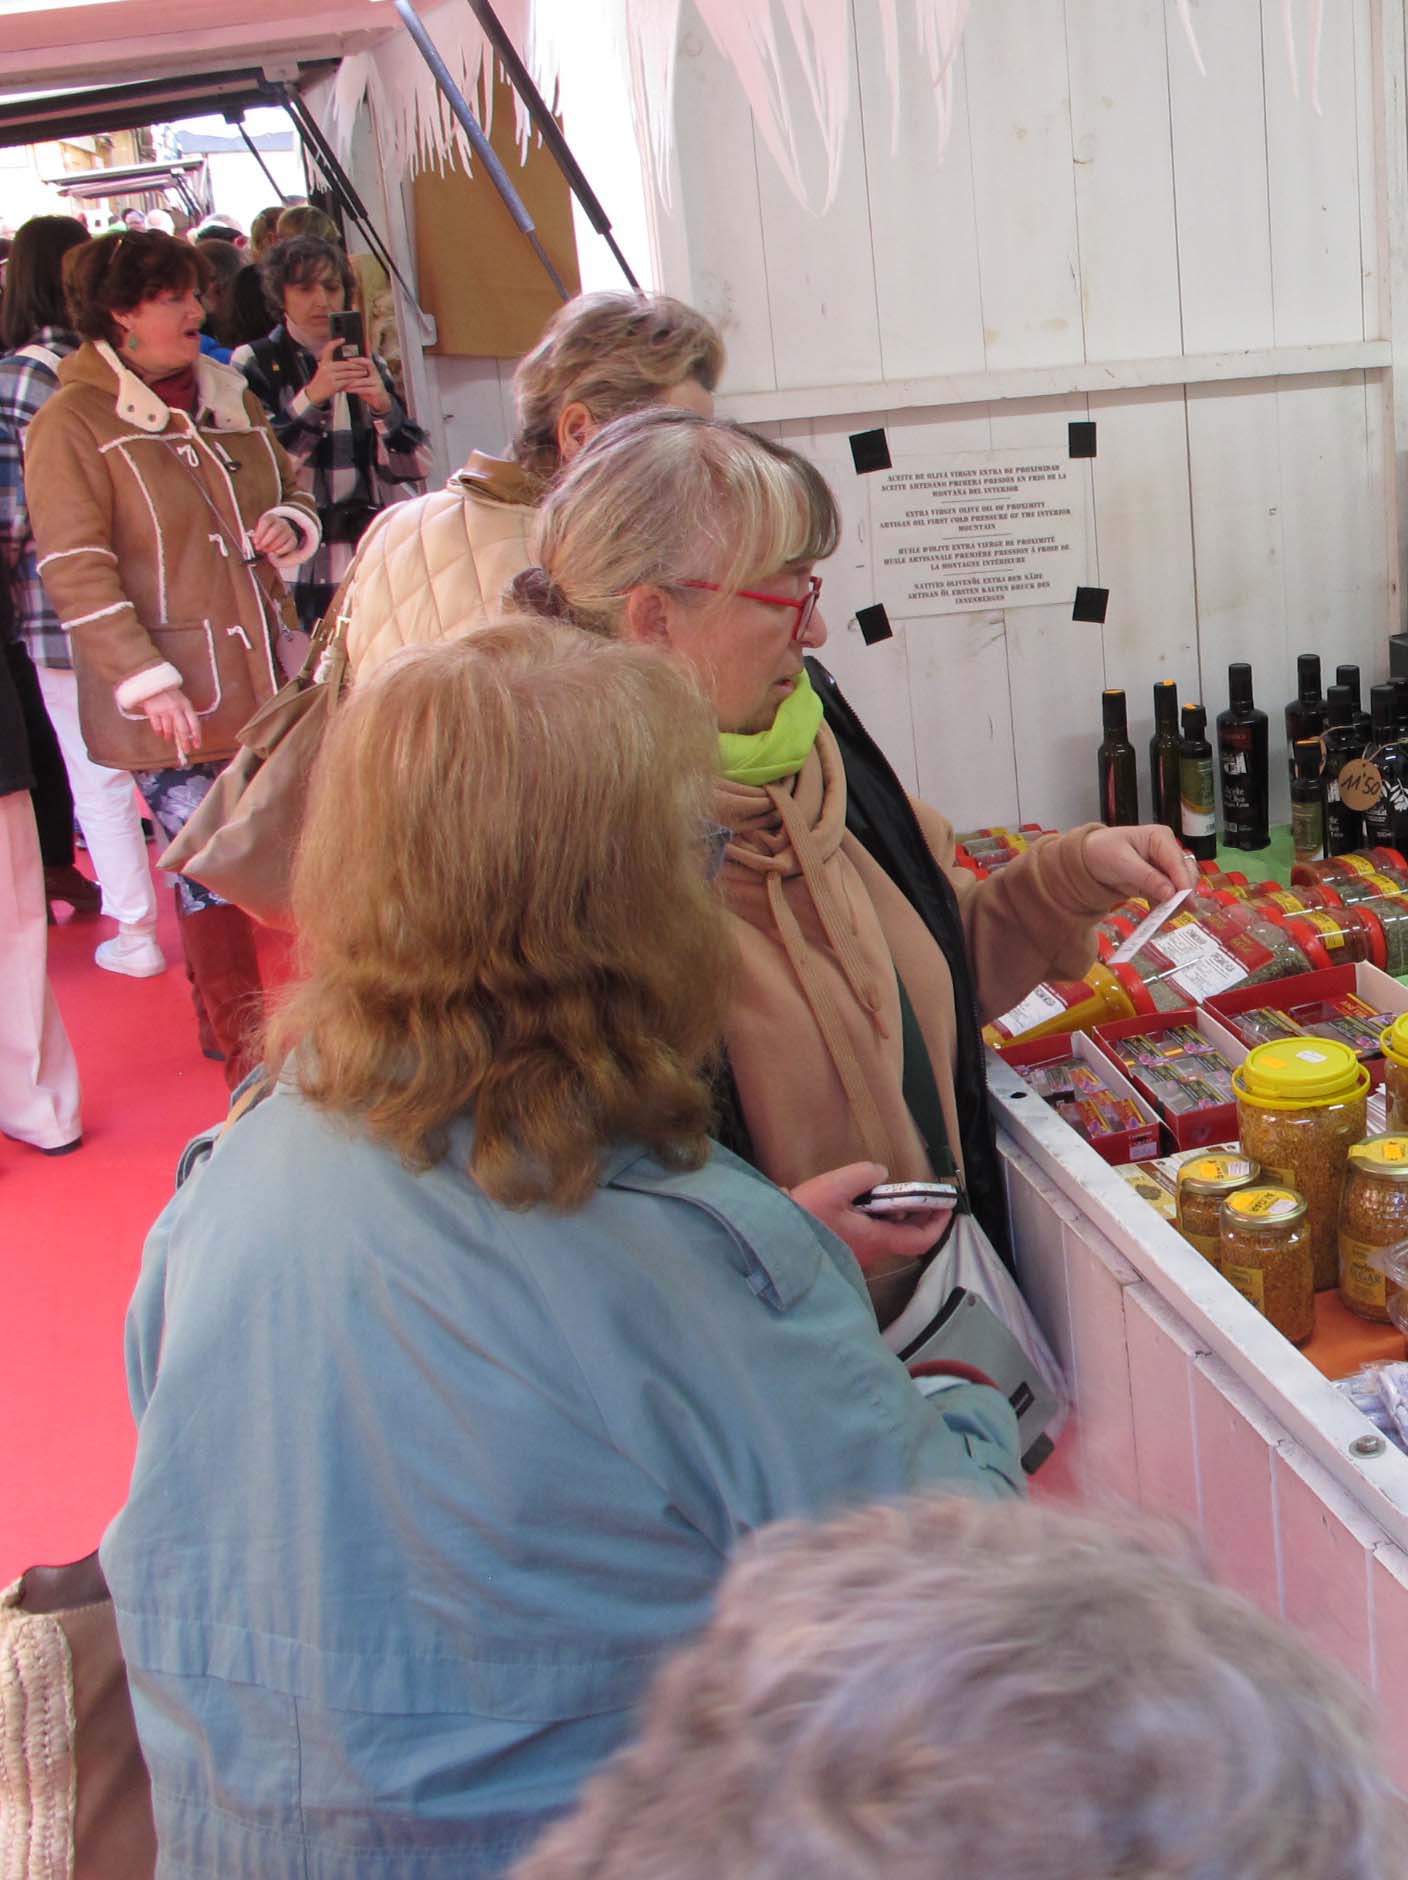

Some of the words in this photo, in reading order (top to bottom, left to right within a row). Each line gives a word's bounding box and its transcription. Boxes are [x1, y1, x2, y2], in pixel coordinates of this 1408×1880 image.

[888, 473, 913, 481] ACEITE
[926, 471, 948, 479] OLIVA
[950, 470, 977, 478] VIRGEN
[979, 468, 1002, 476] EXTRA
[909, 481, 948, 490] ARTESANO
[948, 479, 982, 487] PRIMERA
[984, 485, 1019, 494] INTERIOR
[905, 510, 929, 518] EXTRA
[931, 508, 957, 516] VIRGIN
[1006, 501, 1045, 510] PROXIMITY
[880, 520, 911, 528] ARTISAN
[928, 517, 948, 525] FIRST
[970, 513, 1009, 522] PRESSURE
[1036, 508, 1071, 517] INTERIOR
[958, 523, 996, 532] MOUNTAIN
[898, 546, 920, 555] HUILE
[952, 543, 975, 551] EXTRA
[883, 557, 906, 565] HUILE
[909, 553, 953, 563] ARTISANALE
[993, 547, 1029, 556] PRESSION
[942, 560, 980, 569] MONTAGNE
[982, 576, 1006, 584] EXTRA
[908, 590, 939, 599] ARTISAN
